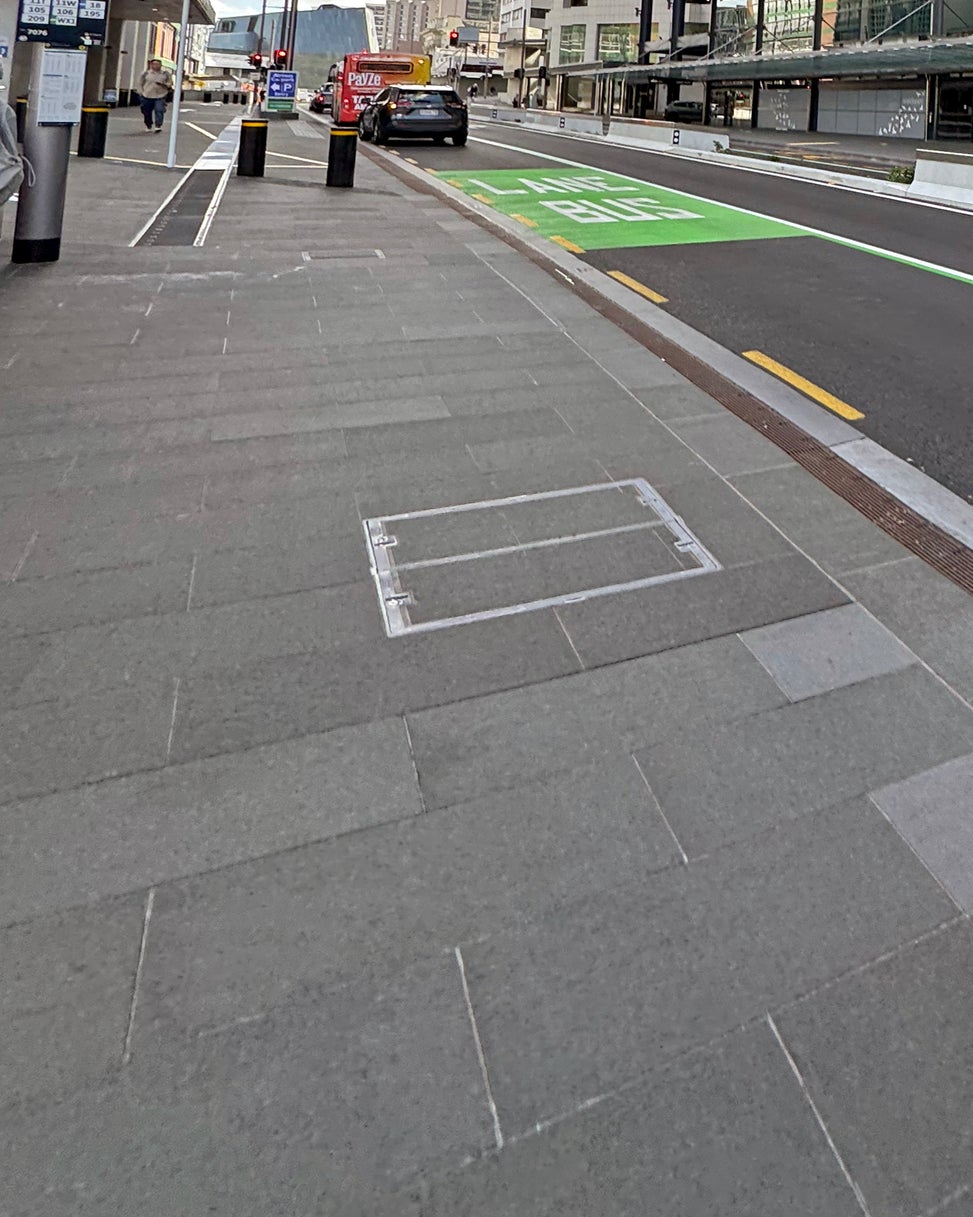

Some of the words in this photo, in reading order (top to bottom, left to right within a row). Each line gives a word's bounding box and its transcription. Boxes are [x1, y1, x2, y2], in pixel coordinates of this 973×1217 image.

[55, 0, 77, 7] 11W
[28, 6, 46, 14] 105
[57, 8, 74, 16] 106
[84, 10, 101, 18] 195
[27, 15, 45, 23] 209
[27, 28, 48, 37] 7076
[468, 176, 640, 195] LANE
[538, 197, 706, 223] BUS
